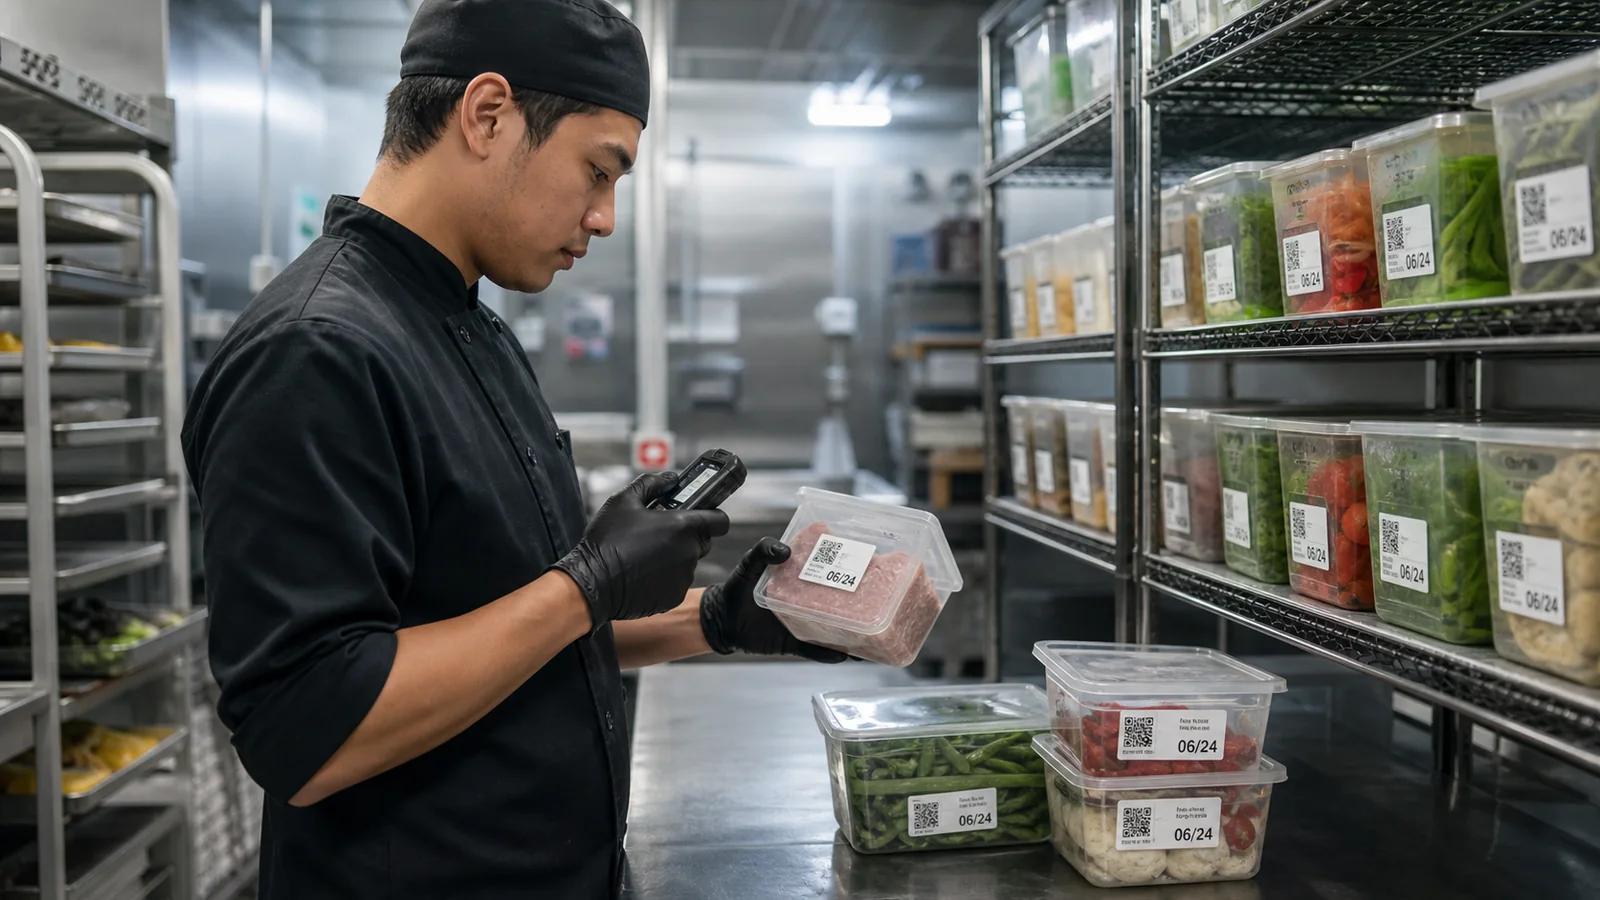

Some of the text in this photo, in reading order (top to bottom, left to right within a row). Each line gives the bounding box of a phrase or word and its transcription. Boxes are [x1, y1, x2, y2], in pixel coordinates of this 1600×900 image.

[1405, 252, 1431, 270] 06/24
[1301, 272, 1321, 288] 06/24
[1306, 545, 1327, 564] 06/24
[826, 570, 857, 587] 06/24
[1400, 563, 1425, 584] 06/24
[1526, 590, 1559, 614] 06/24
[1177, 739, 1218, 754] 06/24
[959, 812, 992, 827] 06/24
[1174, 827, 1213, 842] 06/24
